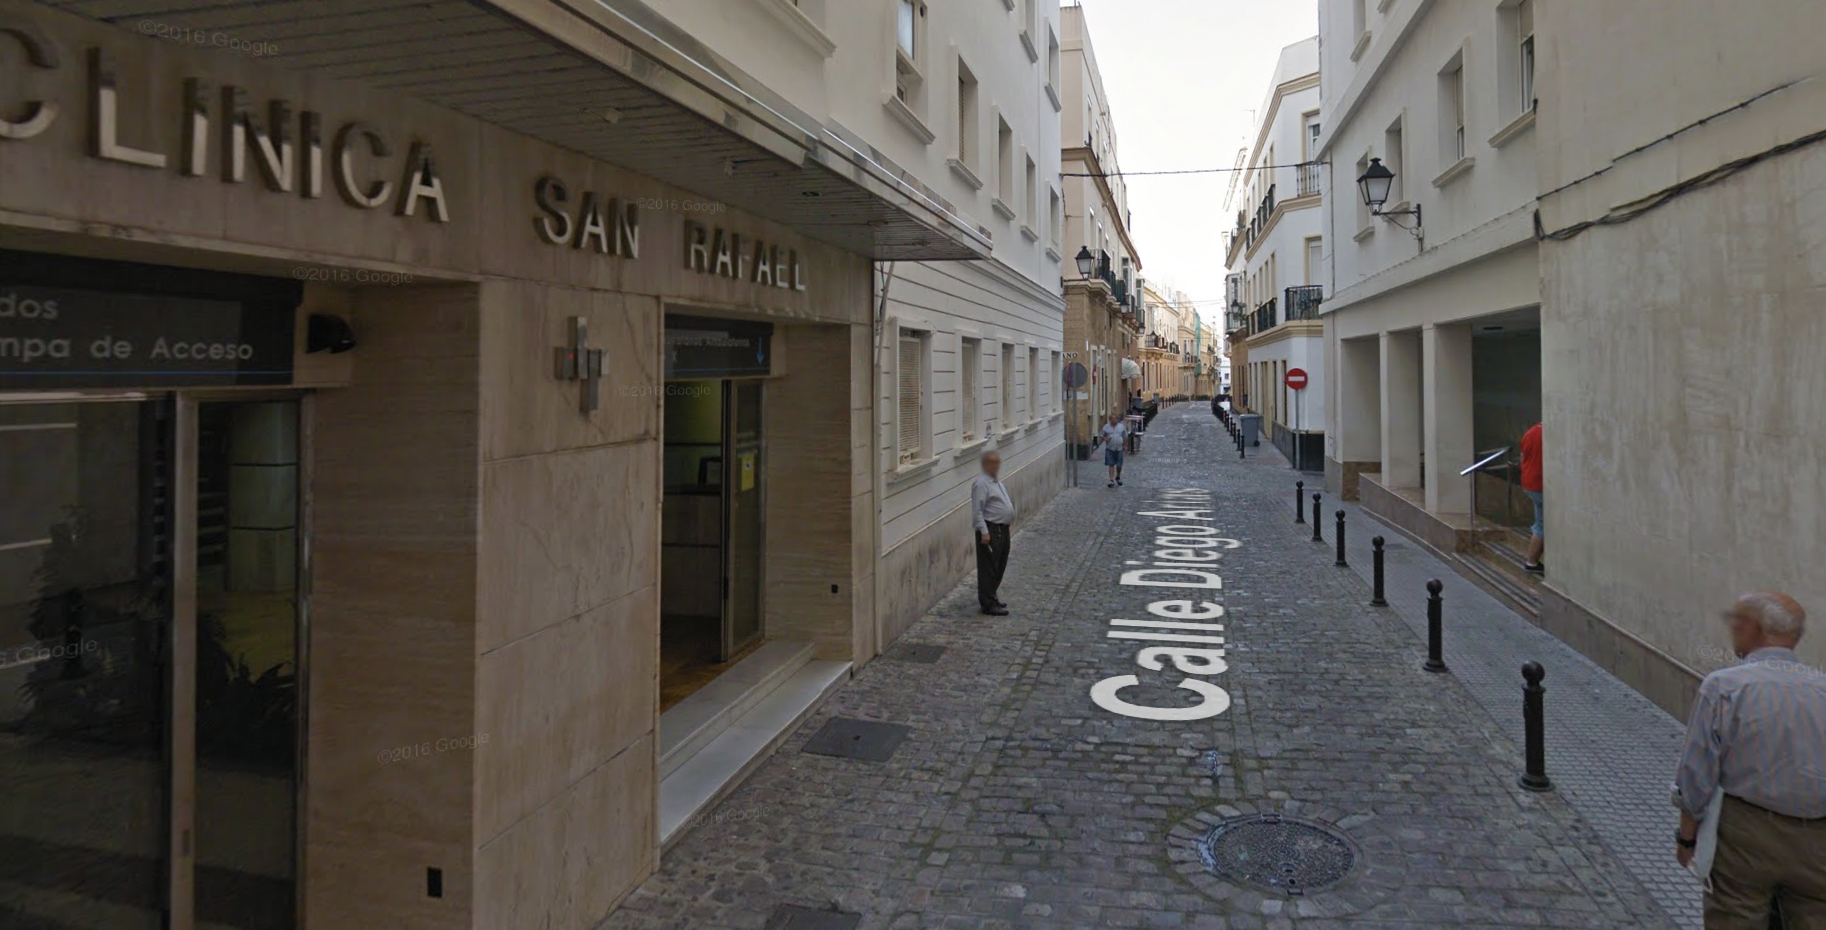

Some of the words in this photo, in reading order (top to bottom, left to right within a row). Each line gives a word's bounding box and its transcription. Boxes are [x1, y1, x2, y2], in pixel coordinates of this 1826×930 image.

[0, 28, 449, 223] CLINICA
[533, 175, 639, 259] SAN
[684, 218, 806, 290] RAFAEL
[90, 334, 133, 360] de
[150, 336, 253, 361] Acceso
